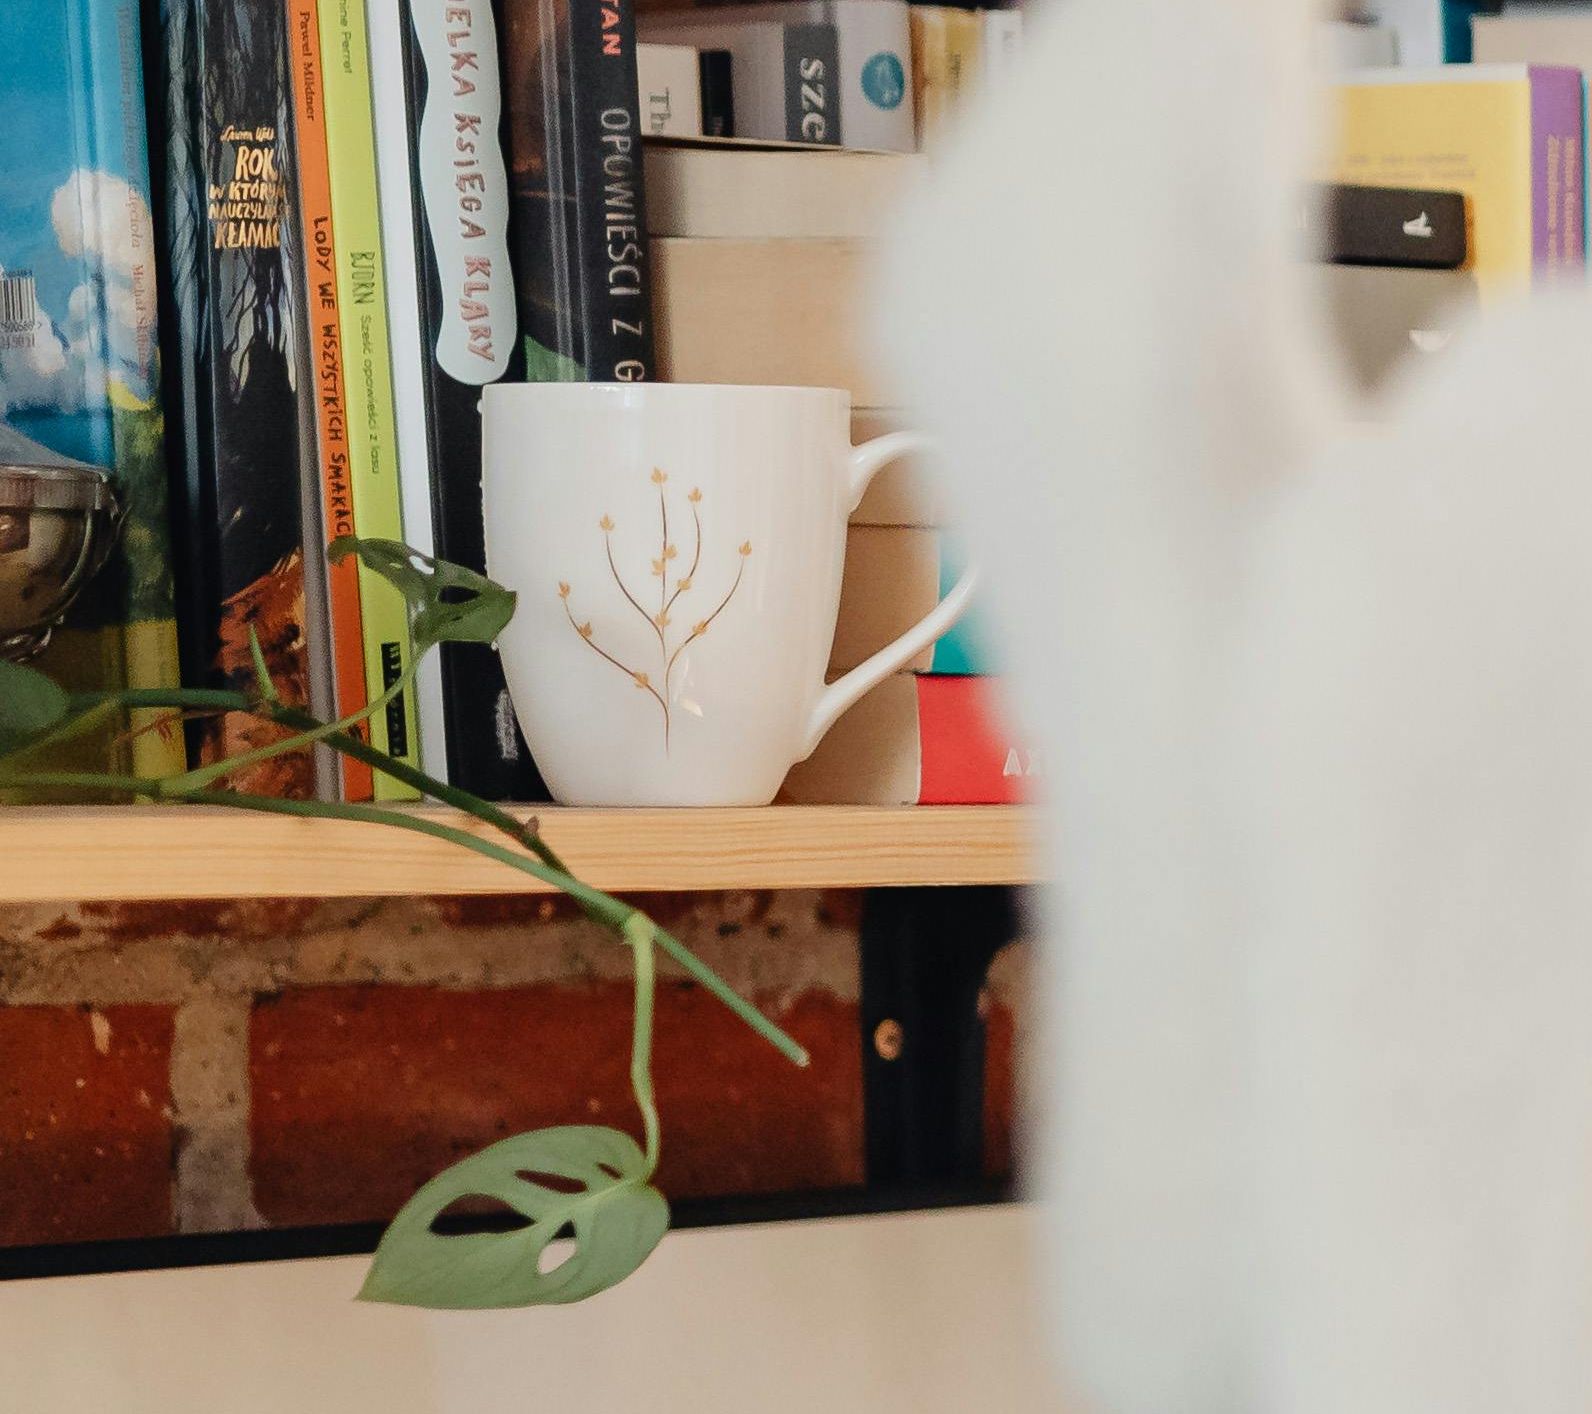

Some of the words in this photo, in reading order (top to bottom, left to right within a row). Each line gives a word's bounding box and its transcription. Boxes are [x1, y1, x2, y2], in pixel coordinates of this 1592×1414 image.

[600, 105, 641, 297] OPOWIEŚCI
[313, 216, 333, 272] LODY
[318, 282, 336, 310] WE
[459, 253, 496, 363] KLARY
[610, 319, 643, 338] Z
[322, 324, 343, 442] WSZYSTKICH
[327, 452, 352, 533] SMAKAC
